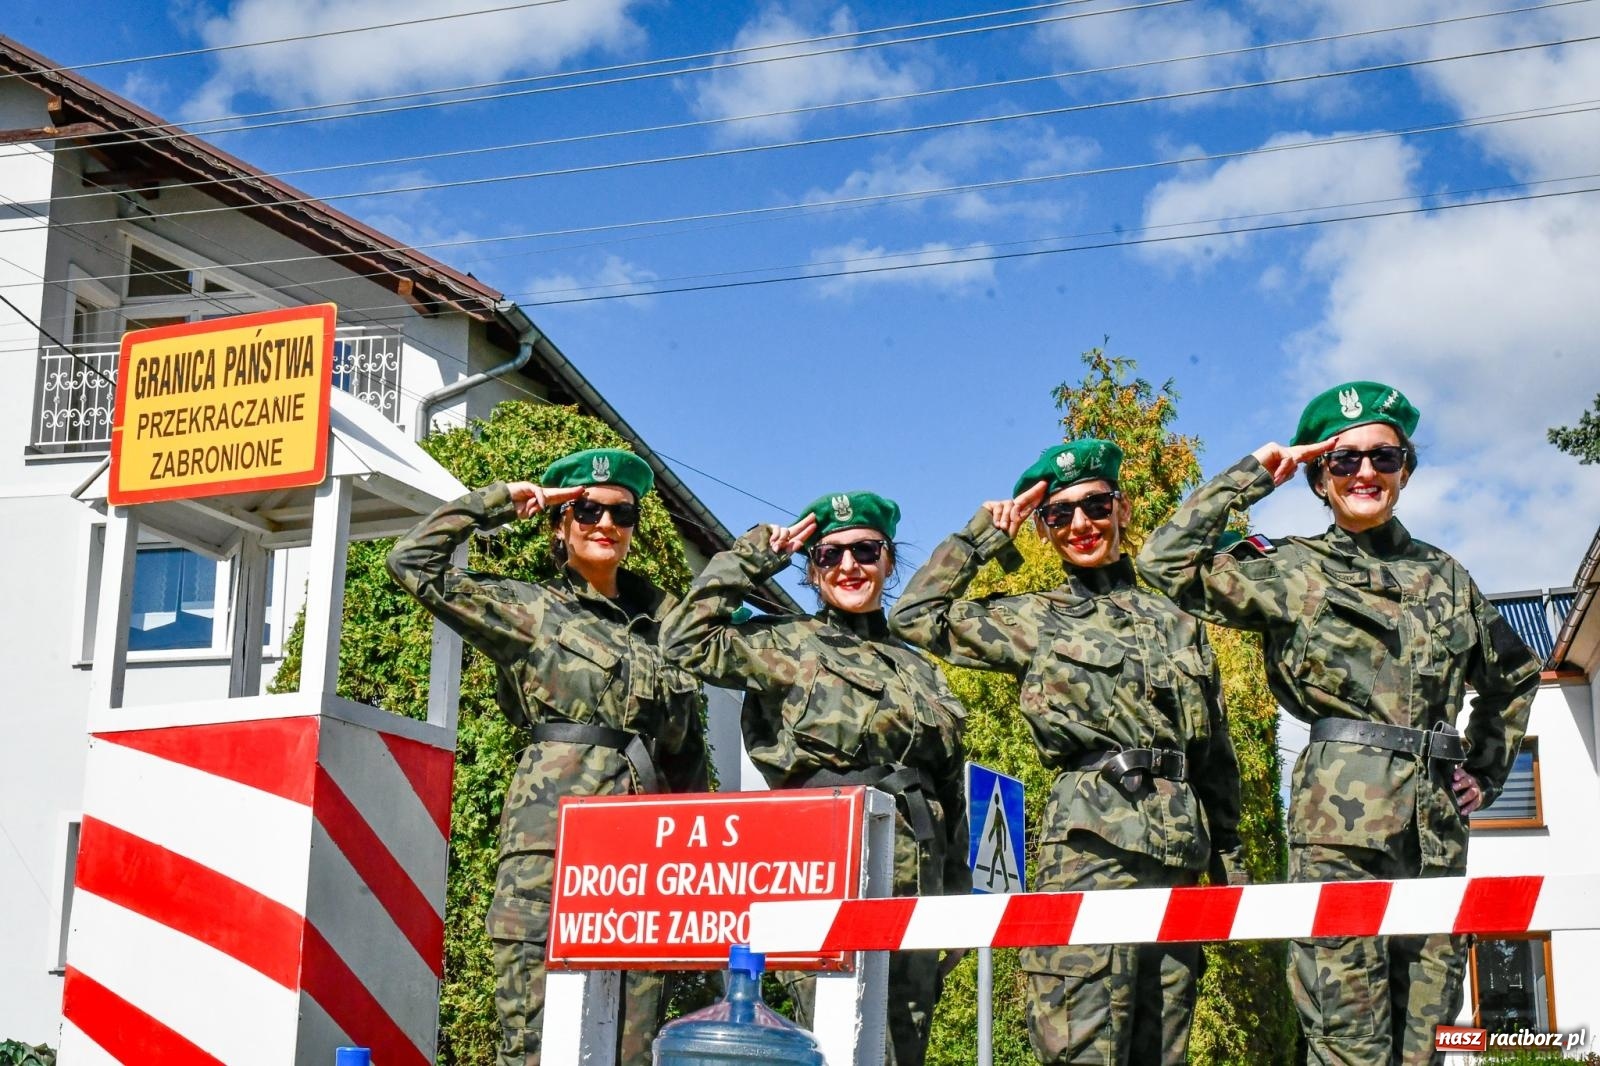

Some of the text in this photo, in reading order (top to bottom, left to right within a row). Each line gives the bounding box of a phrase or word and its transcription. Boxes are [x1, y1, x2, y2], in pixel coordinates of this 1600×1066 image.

[134, 328, 314, 400] GRANICA PAŃSTWA
[136, 393, 305, 441] PRZEKRACZANIE
[149, 437, 283, 481] ZABRONIONE
[563, 861, 836, 897] DROGI GRANICZNEJ
[559, 907, 660, 945] WEJŚCIE
